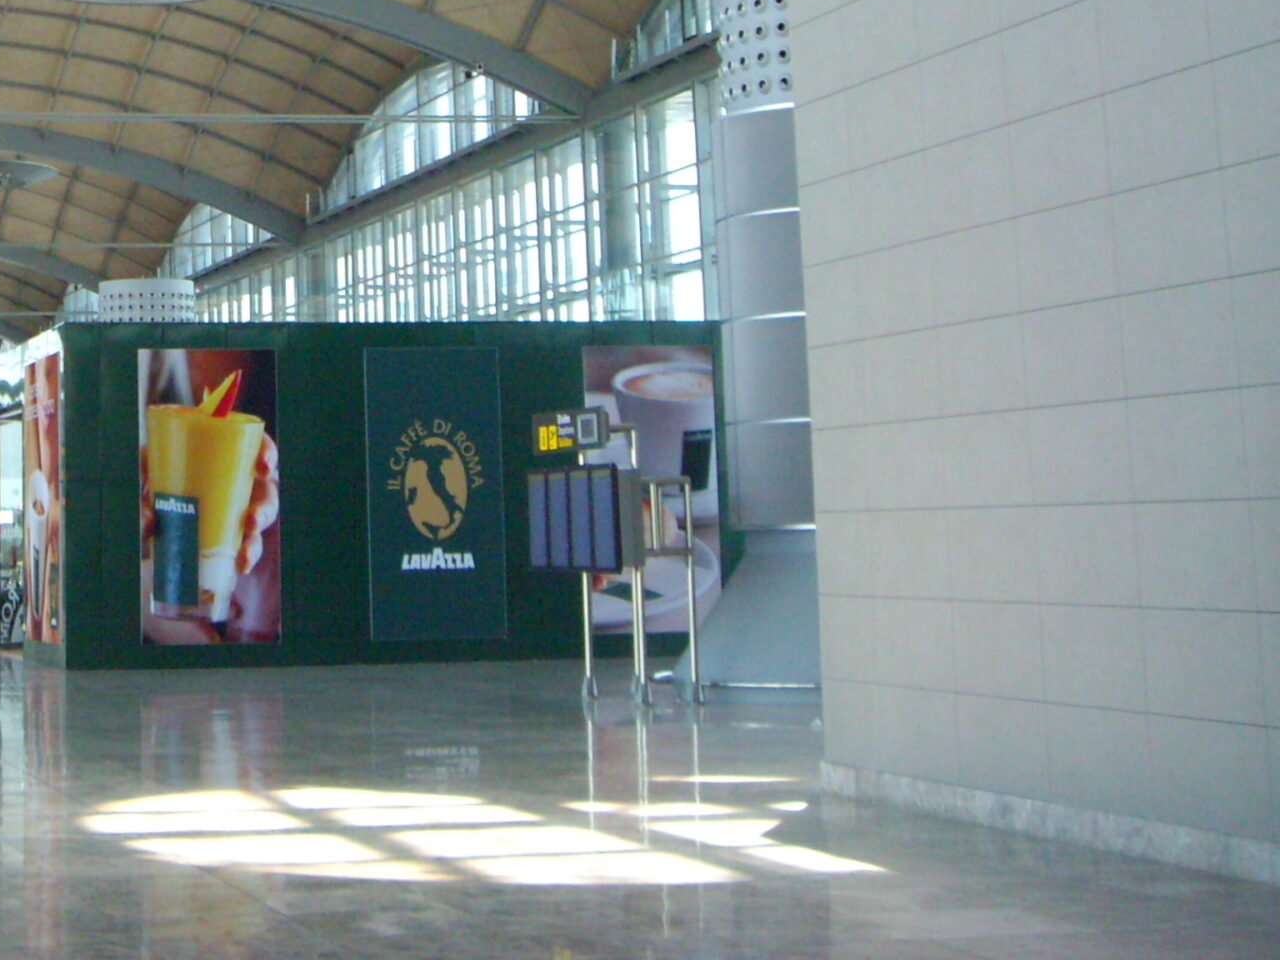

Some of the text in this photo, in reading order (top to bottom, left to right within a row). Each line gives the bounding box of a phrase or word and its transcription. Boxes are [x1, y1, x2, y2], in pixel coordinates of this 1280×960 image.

[433, 419, 453, 435] DI
[453, 431, 485, 488] ROMA
[154, 497, 196, 514] LAVAZZA
[401, 547, 476, 571] LAVAZZA
